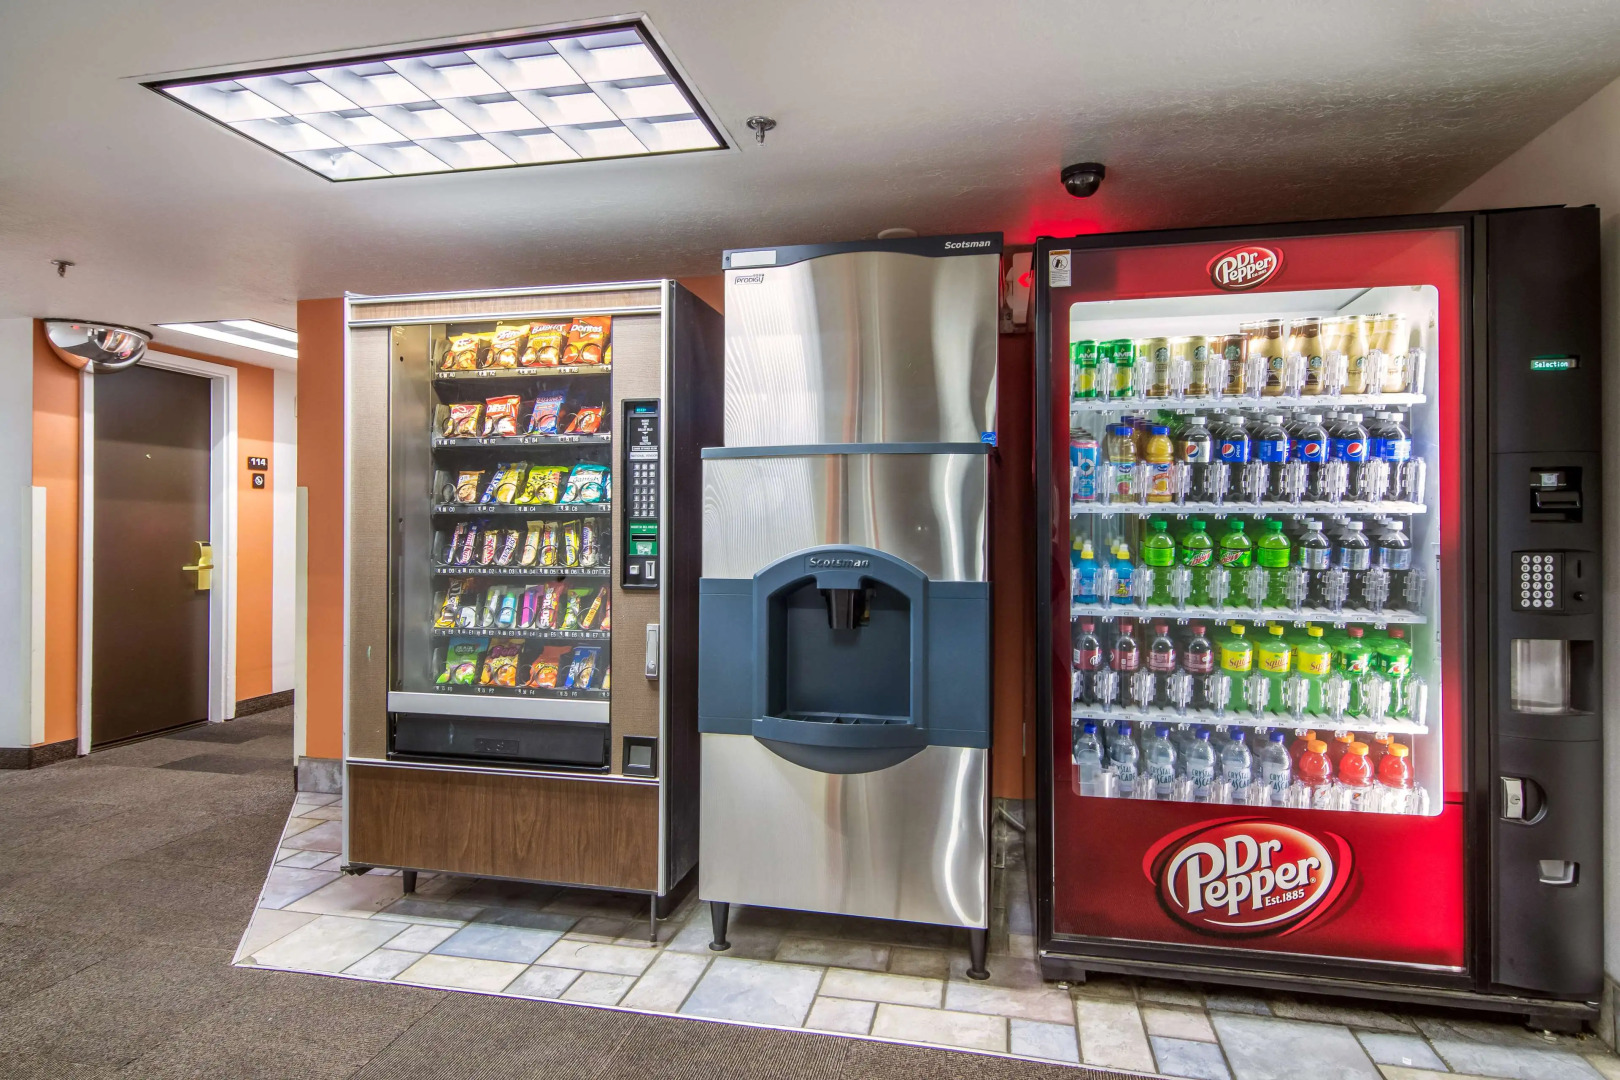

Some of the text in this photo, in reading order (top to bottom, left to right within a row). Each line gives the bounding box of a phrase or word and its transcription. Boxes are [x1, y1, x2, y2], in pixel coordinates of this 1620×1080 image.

[944, 239, 991, 250] Scotsman
[1236, 252, 1258, 268] Dr
[1216, 256, 1272, 284] Pepper
[570, 324, 603, 333] Doritos
[251, 458, 266, 466] 114
[809, 556, 870, 569] Scotsman
[541, 587, 554, 626] Skittles
[1224, 834, 1282, 877] Dr
[1168, 842, 1320, 916] Pepper
[1265, 888, 1305, 906] Est.1885
